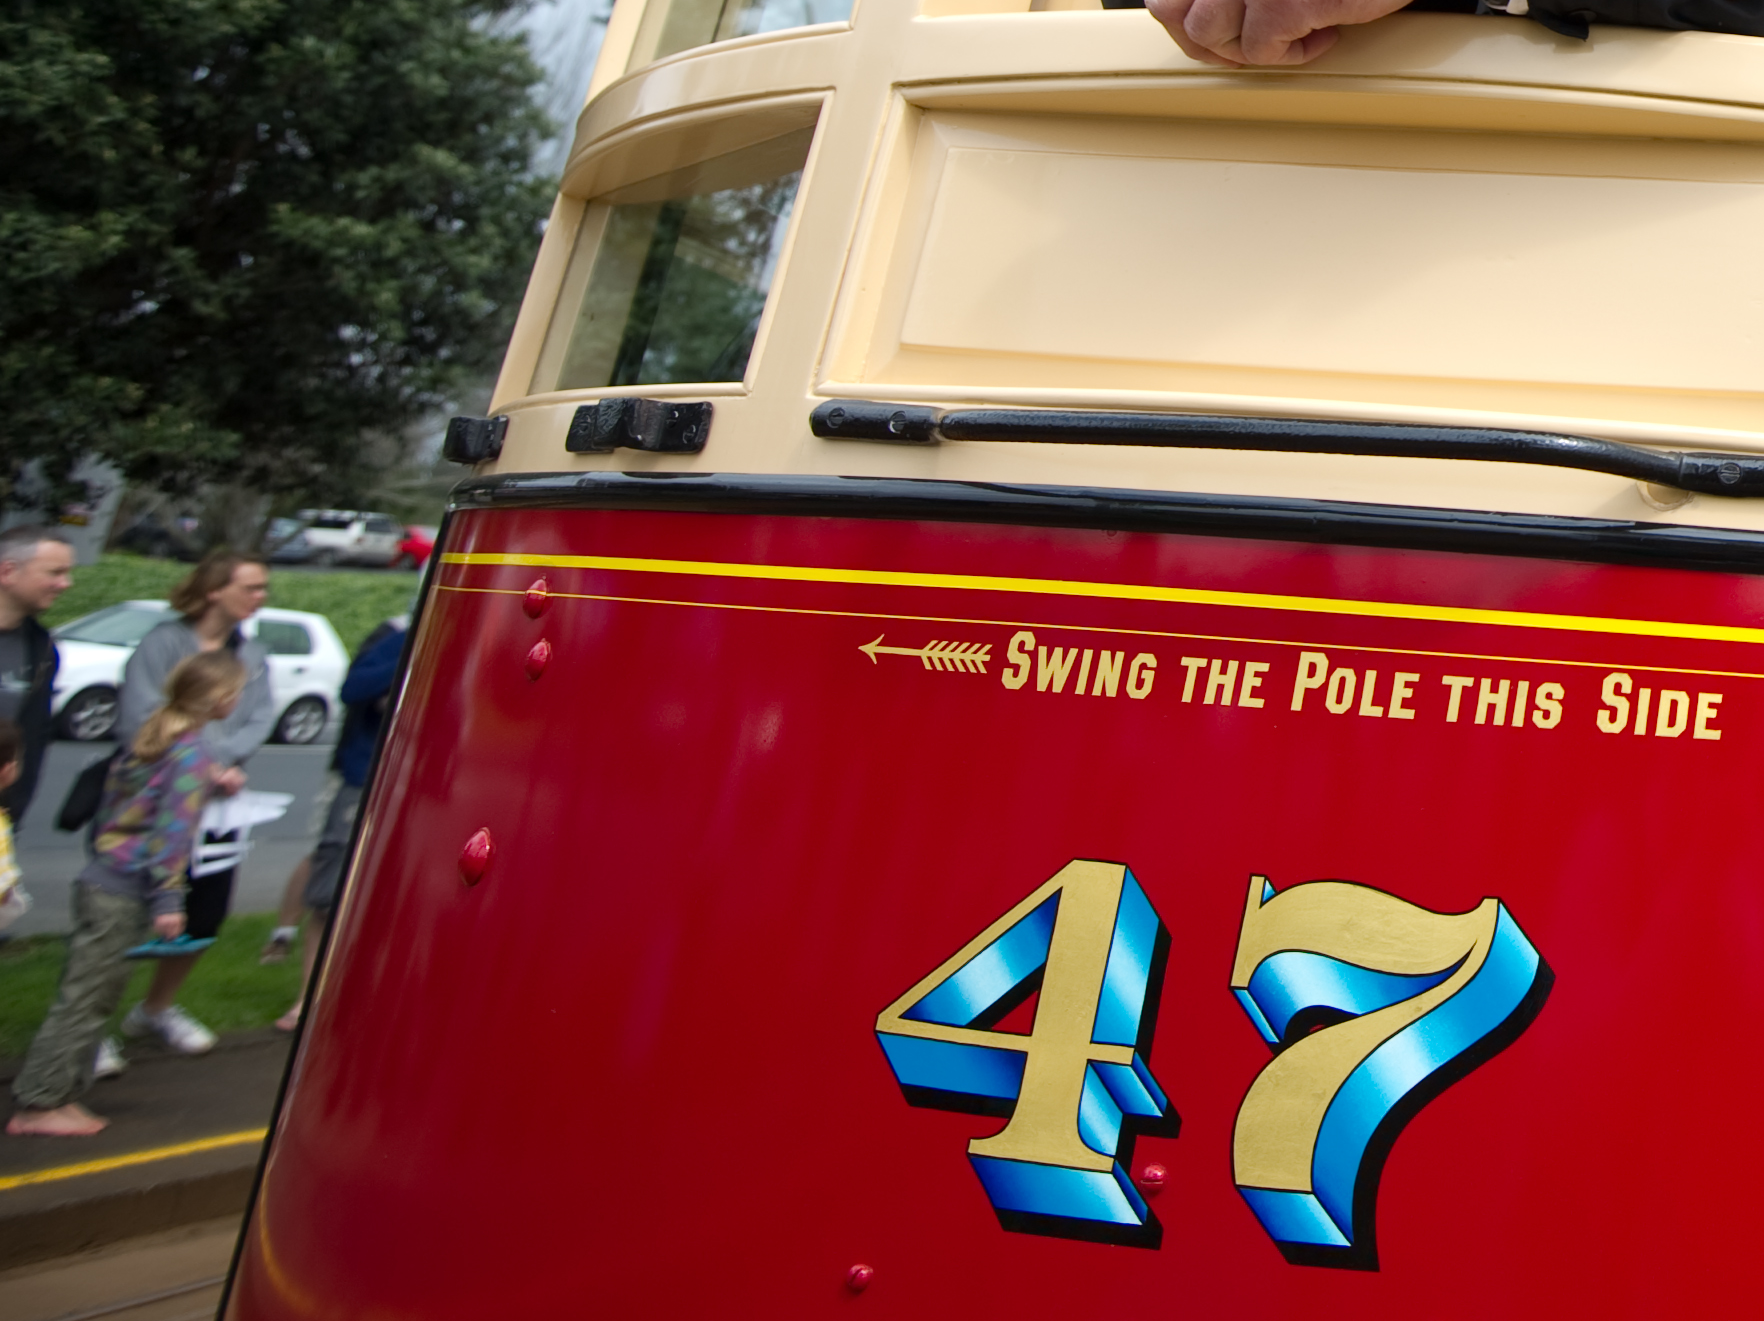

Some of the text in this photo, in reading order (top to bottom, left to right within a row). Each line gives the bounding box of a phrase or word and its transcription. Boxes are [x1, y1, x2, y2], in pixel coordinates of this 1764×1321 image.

[1180, 656, 1271, 709] THE
[1441, 674, 1565, 730] THIS
[874, 857, 1556, 1273] 47
